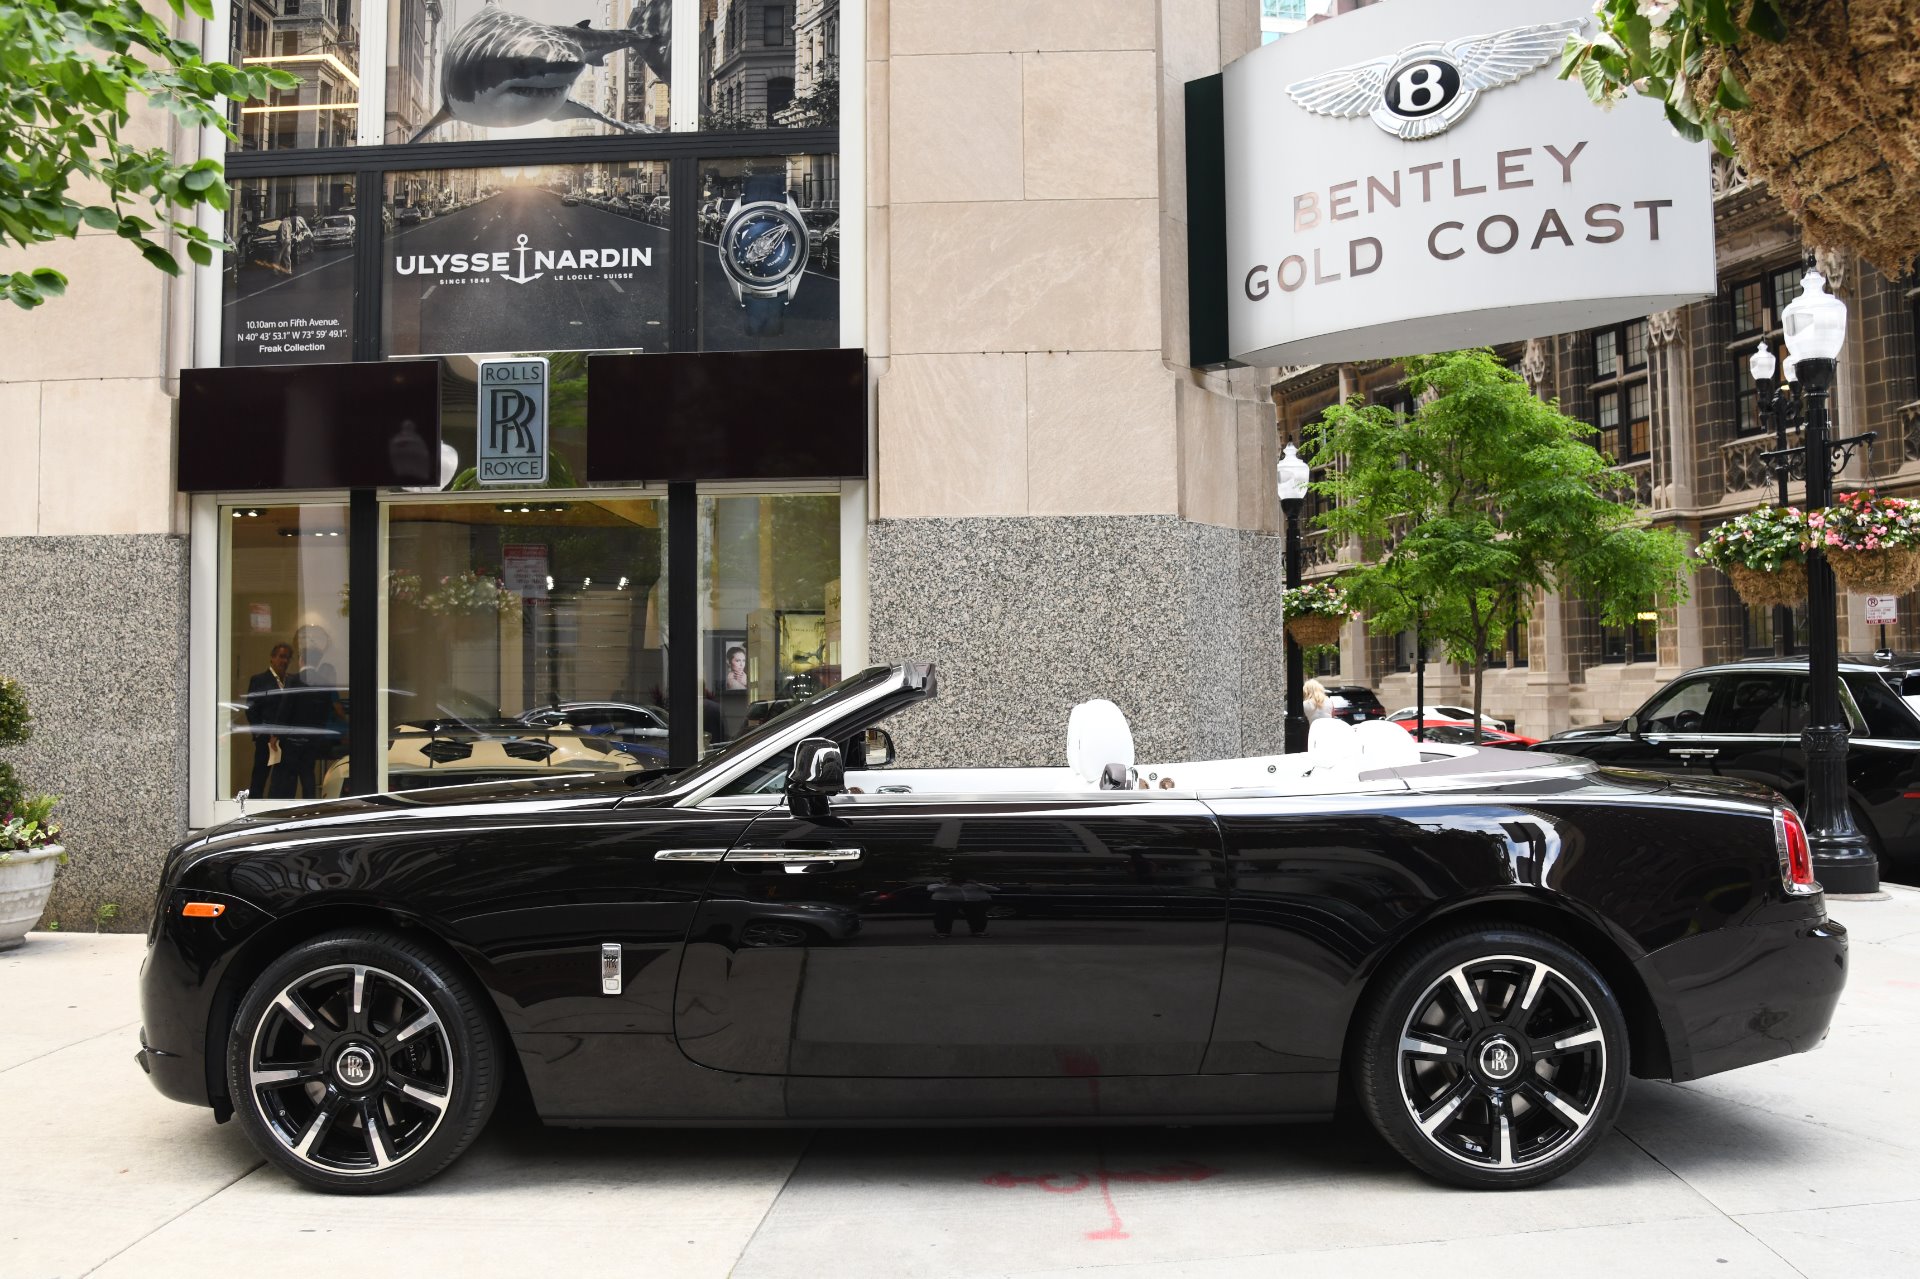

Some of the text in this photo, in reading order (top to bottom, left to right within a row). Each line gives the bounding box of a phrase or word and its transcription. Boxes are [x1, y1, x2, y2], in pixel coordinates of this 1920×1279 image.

[1293, 141, 1589, 233] BENTLEY
[1245, 199, 1673, 302] GOLD COAST
[396, 247, 652, 275] ULYSSE NARDIN
[246, 320, 276, 329] 10.10am
[290, 318, 307, 327] Fifth
[309, 318, 340, 327] Avenue.
[237, 333, 244, 341] N
[292, 331, 300, 339] W
[259, 342, 325, 353] Freak Collection
[485, 366, 540, 381] ROLLS
[484, 461, 539, 476] ROYCE
